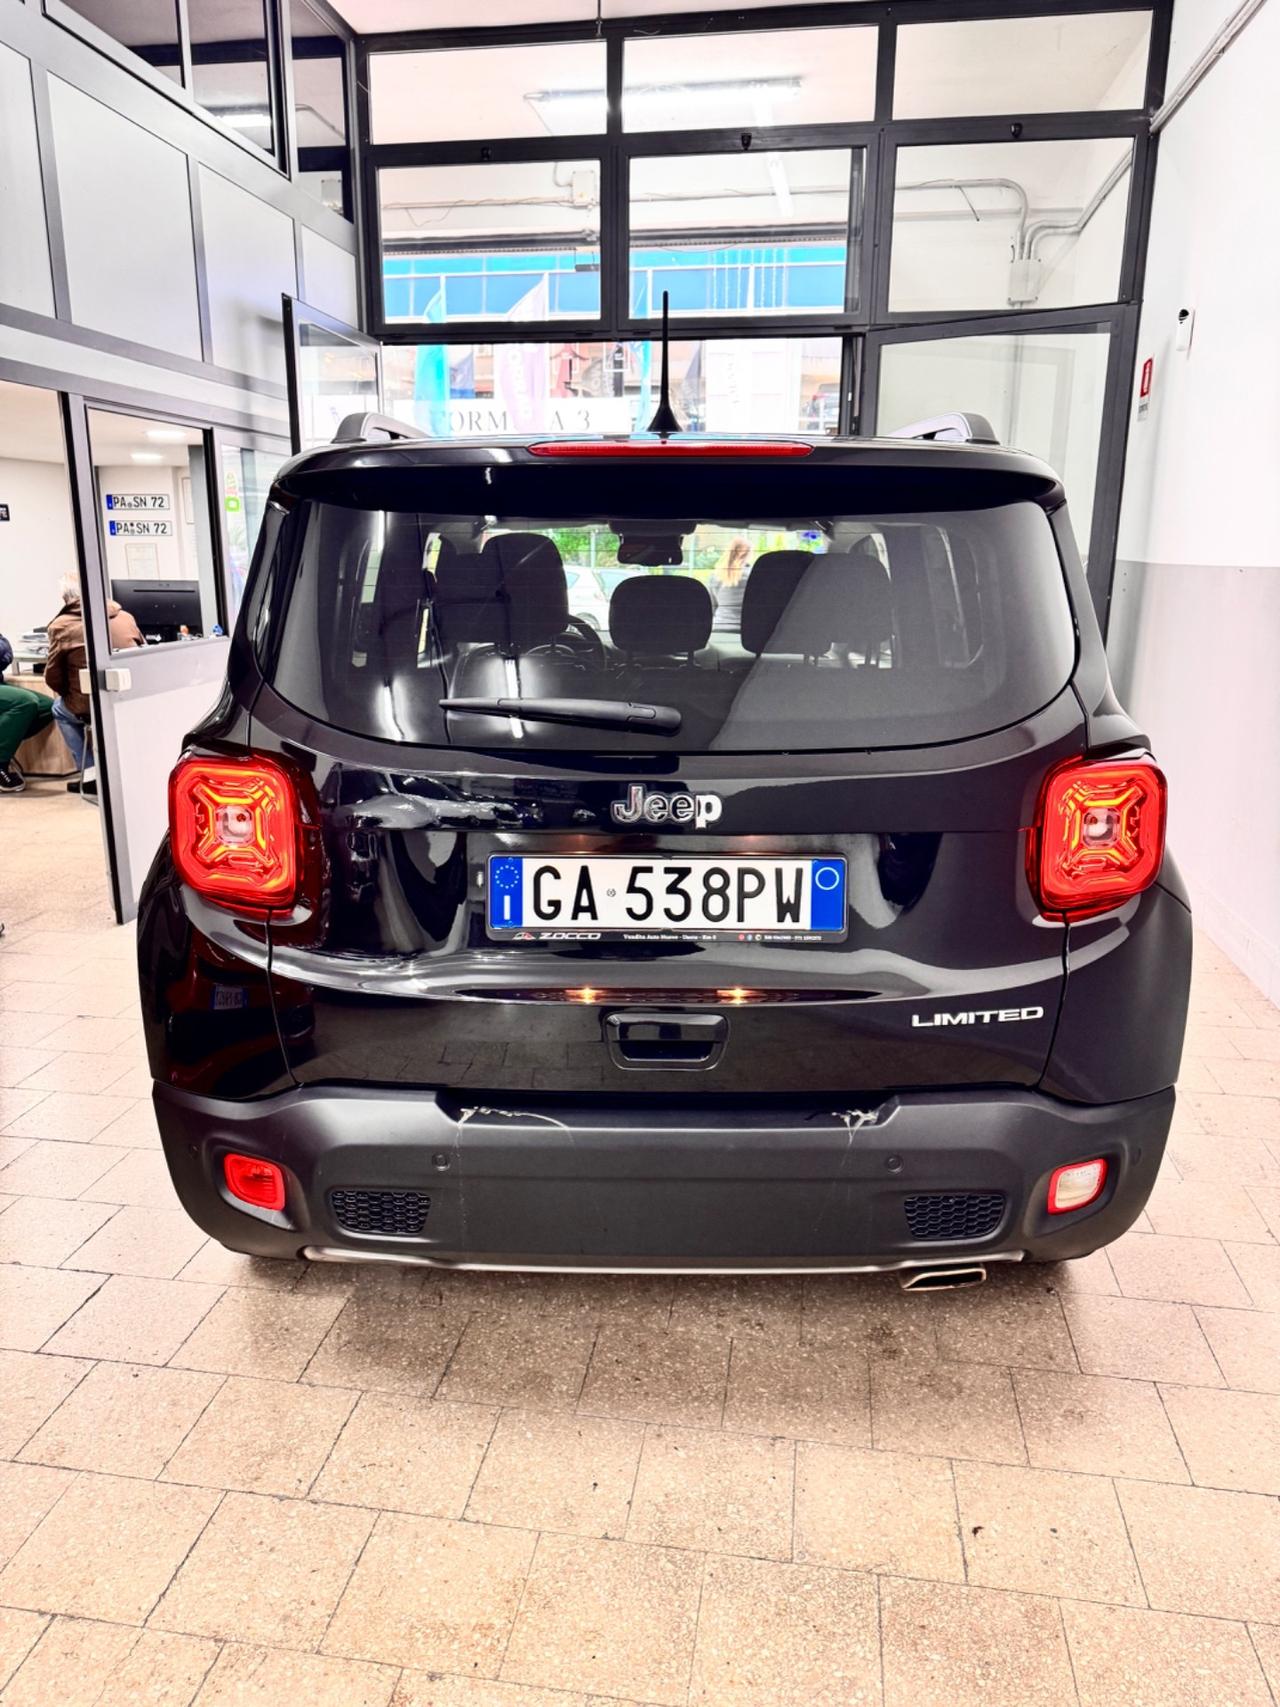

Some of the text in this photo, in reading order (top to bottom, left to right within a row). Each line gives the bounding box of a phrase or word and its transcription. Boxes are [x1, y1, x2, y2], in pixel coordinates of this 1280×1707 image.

[151, 496, 165, 508] 72
[154, 522, 167, 534] 72
[611, 784, 722, 829] Jeep
[533, 864, 599, 921] GA
[625, 865, 803, 923] 538PW
[539, 932, 602, 940] ZOCCO
[911, 1006, 1044, 1027] LIMITED
